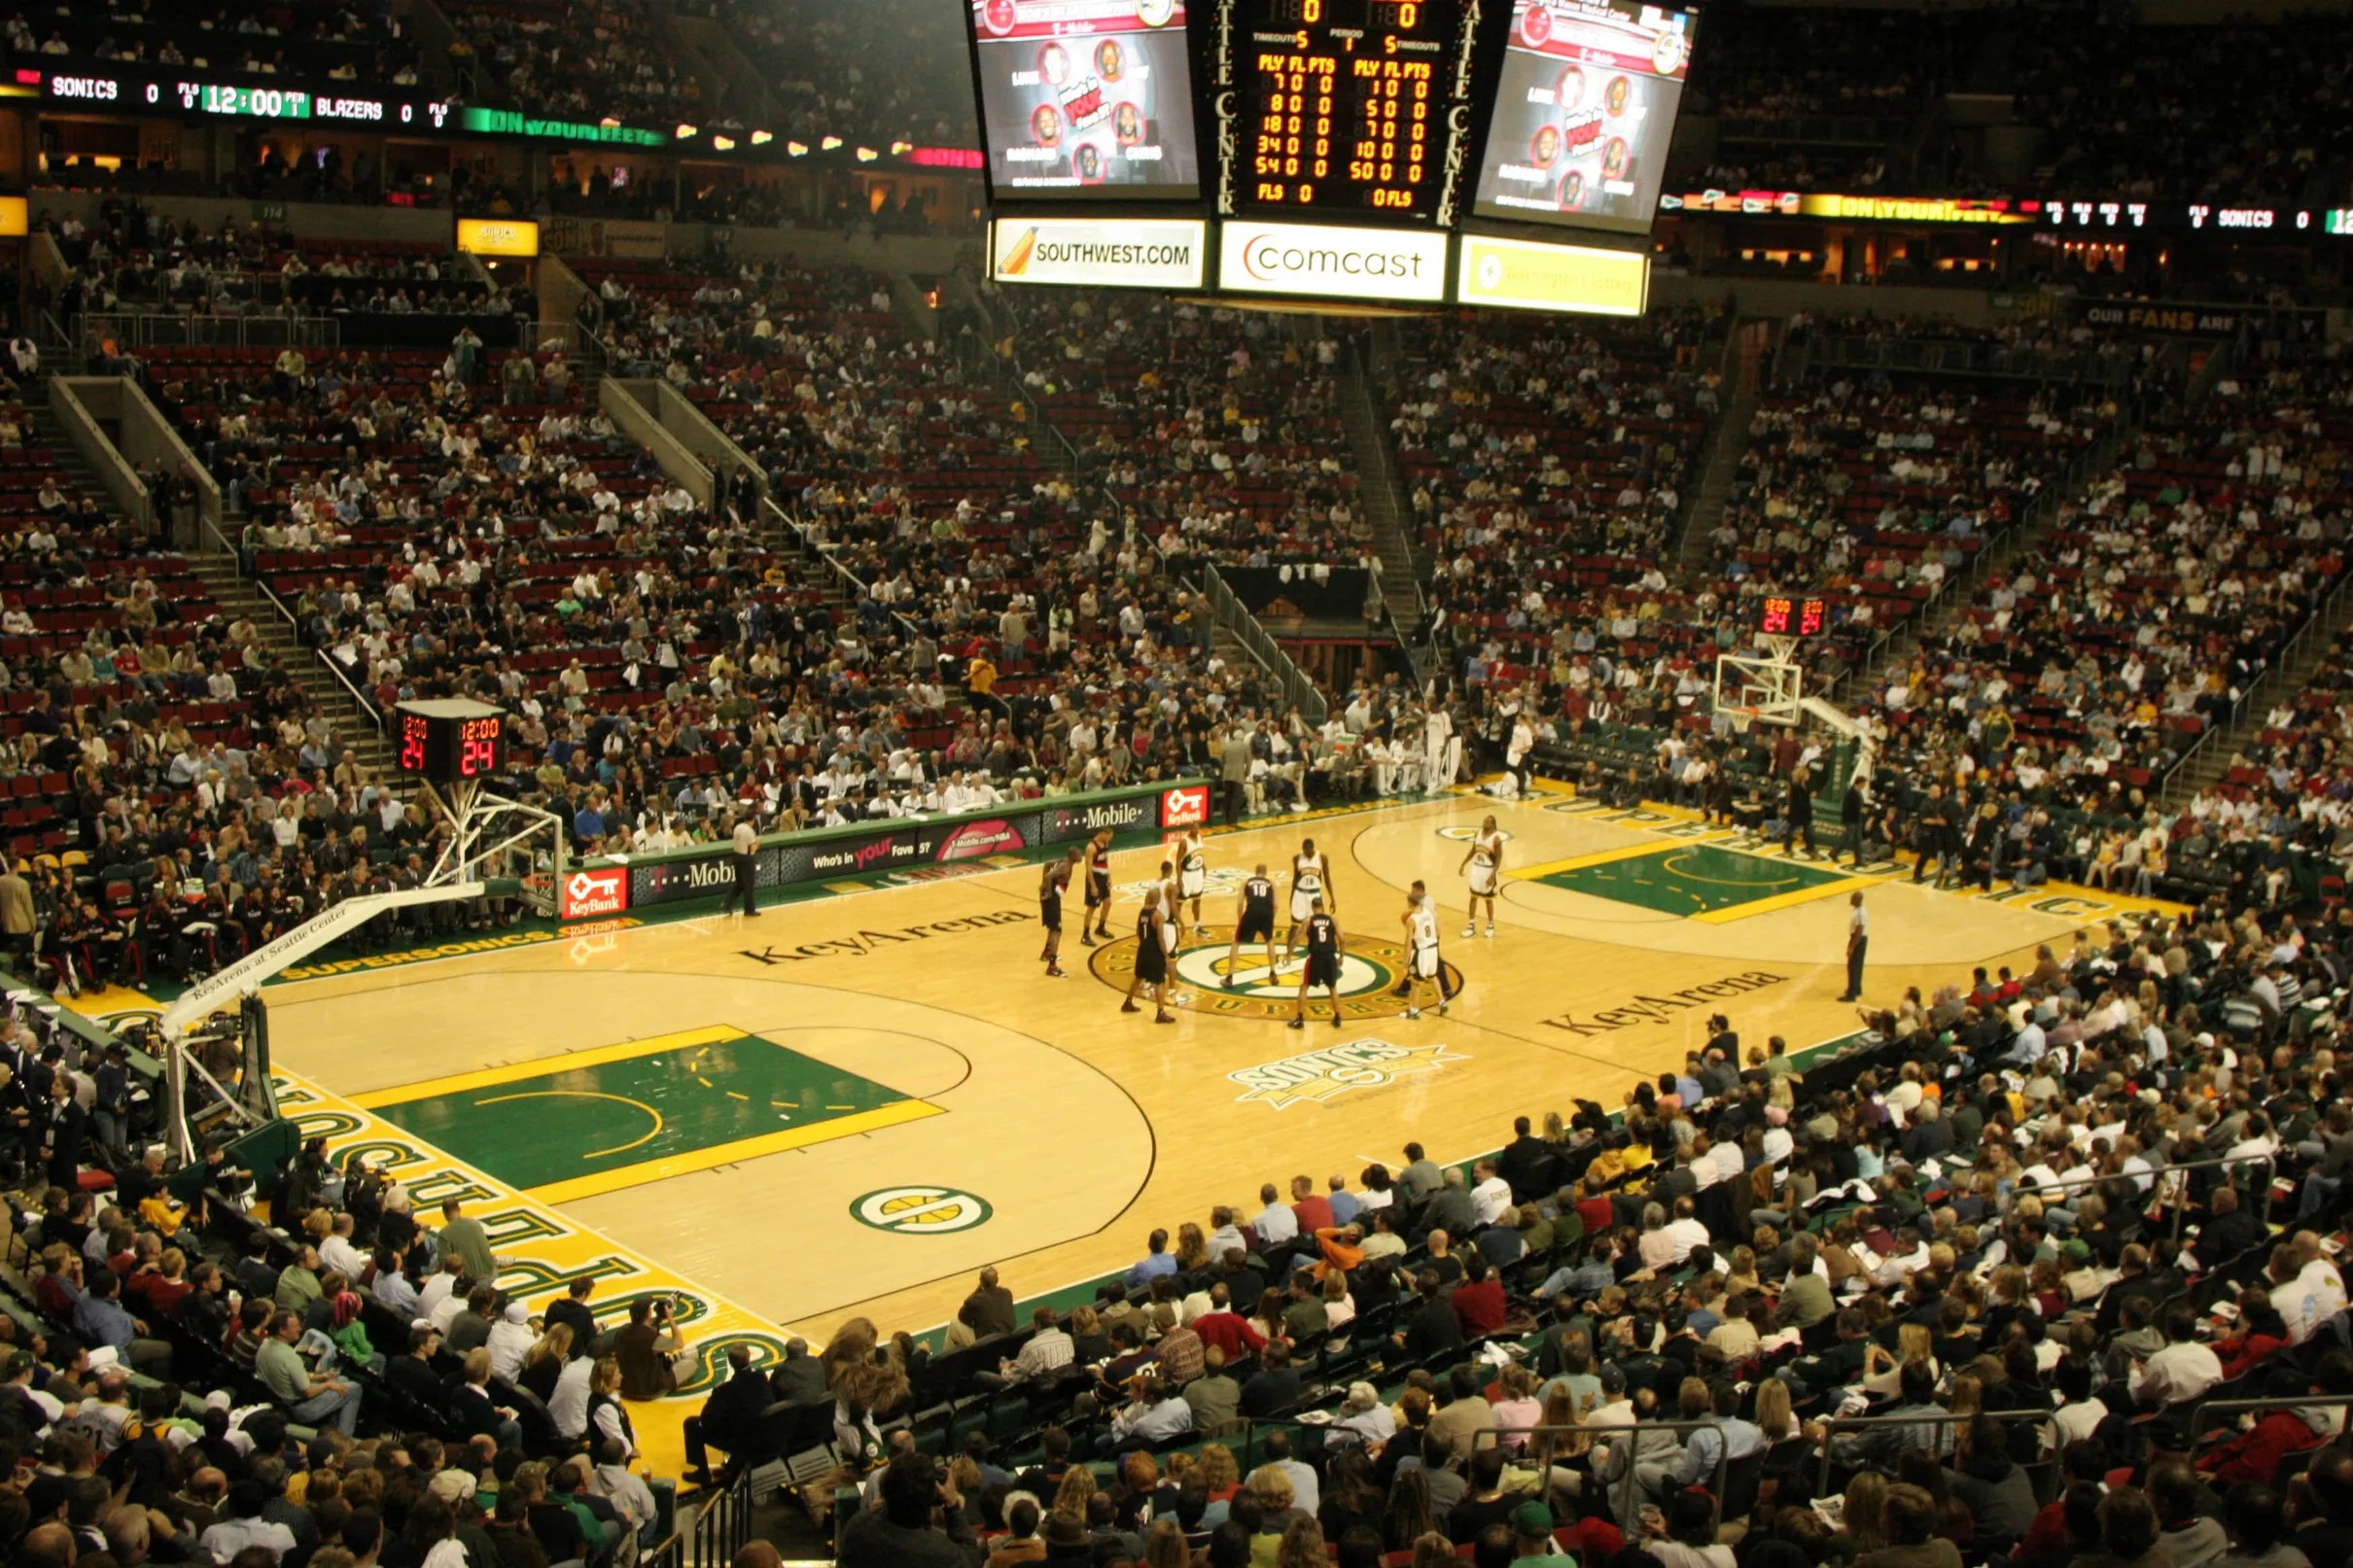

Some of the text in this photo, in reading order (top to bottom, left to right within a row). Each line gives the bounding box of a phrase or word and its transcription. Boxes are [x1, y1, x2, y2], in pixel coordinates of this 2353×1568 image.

[1399, 3, 1416, 27] 0
[1253, 32, 1297, 43] TIMEOUTS
[1329, 28, 1363, 39] PERIOD
[1396, 40, 1441, 52] TIMEOUTS
[1258, 54, 1284, 71] PLY
[1309, 57, 1335, 74] PTS
[1354, 59, 1380, 76] PLY
[1404, 62, 1430, 79] PTS
[52, 77, 117, 99] SONICS
[147, 84, 158, 103] 0
[1275, 74, 1332, 93] 7 0 0
[1386, 80, 1398, 97] 0
[1415, 81, 1427, 98] 0
[184, 94, 193, 109] 0
[207, 86, 282, 117] 12:00
[316, 97, 382, 121] BLAZERS
[402, 104, 412, 122] 0
[1271, 94, 1331, 114] 8 0 0
[1385, 100, 1396, 118] 0
[1414, 102, 1425, 120] 0
[435, 114, 443, 127] 0
[1264, 116, 1330, 135] 18 0 0
[1383, 121, 1395, 139] 0
[1412, 122, 1424, 141] 0
[1215, 91, 1237, 214] CENTER
[1258, 136, 1328, 156] 34 0 0
[1382, 142, 1393, 159] 0
[1410, 144, 1422, 161] 0
[1255, 157, 1327, 177] 54 0 0
[1380, 162, 1392, 181] 0
[1409, 164, 1422, 183] 0
[1436, 105, 1469, 226] CENTER
[1258, 184, 1312, 202] FLS 0
[1373, 189, 1412, 207] 0 FLS
[2219, 208, 2273, 228] SONICS
[2297, 211, 2308, 228] 0
[1036, 243, 1189, 264] SOUTHWEST.COM
[1258, 247, 1422, 277] comcast
[2089, 308, 2123, 324] OUR
[2128, 309, 2195, 331] FANS
[1764, 611, 1787, 632] 24
[1801, 613, 1820, 635] 24
[461, 718, 499, 740] 12:00
[403, 735, 424, 769] 24
[461, 741, 494, 775] 24
[1085, 804, 1137, 828] Mobile
[814, 837, 931, 870] Who's in your Fave 5?
[689, 861, 735, 888] Mobi
[569, 896, 618, 916] KeyBank
[732, 909, 1038, 965] KeyArena
[193, 907, 347, 1000] KeyArena at Seattle Center
[281, 931, 554, 981] SUPERSONICS
[1542, 971, 1789, 1037] KeyArena
[1233, 1038, 1411, 1090] SONICS
